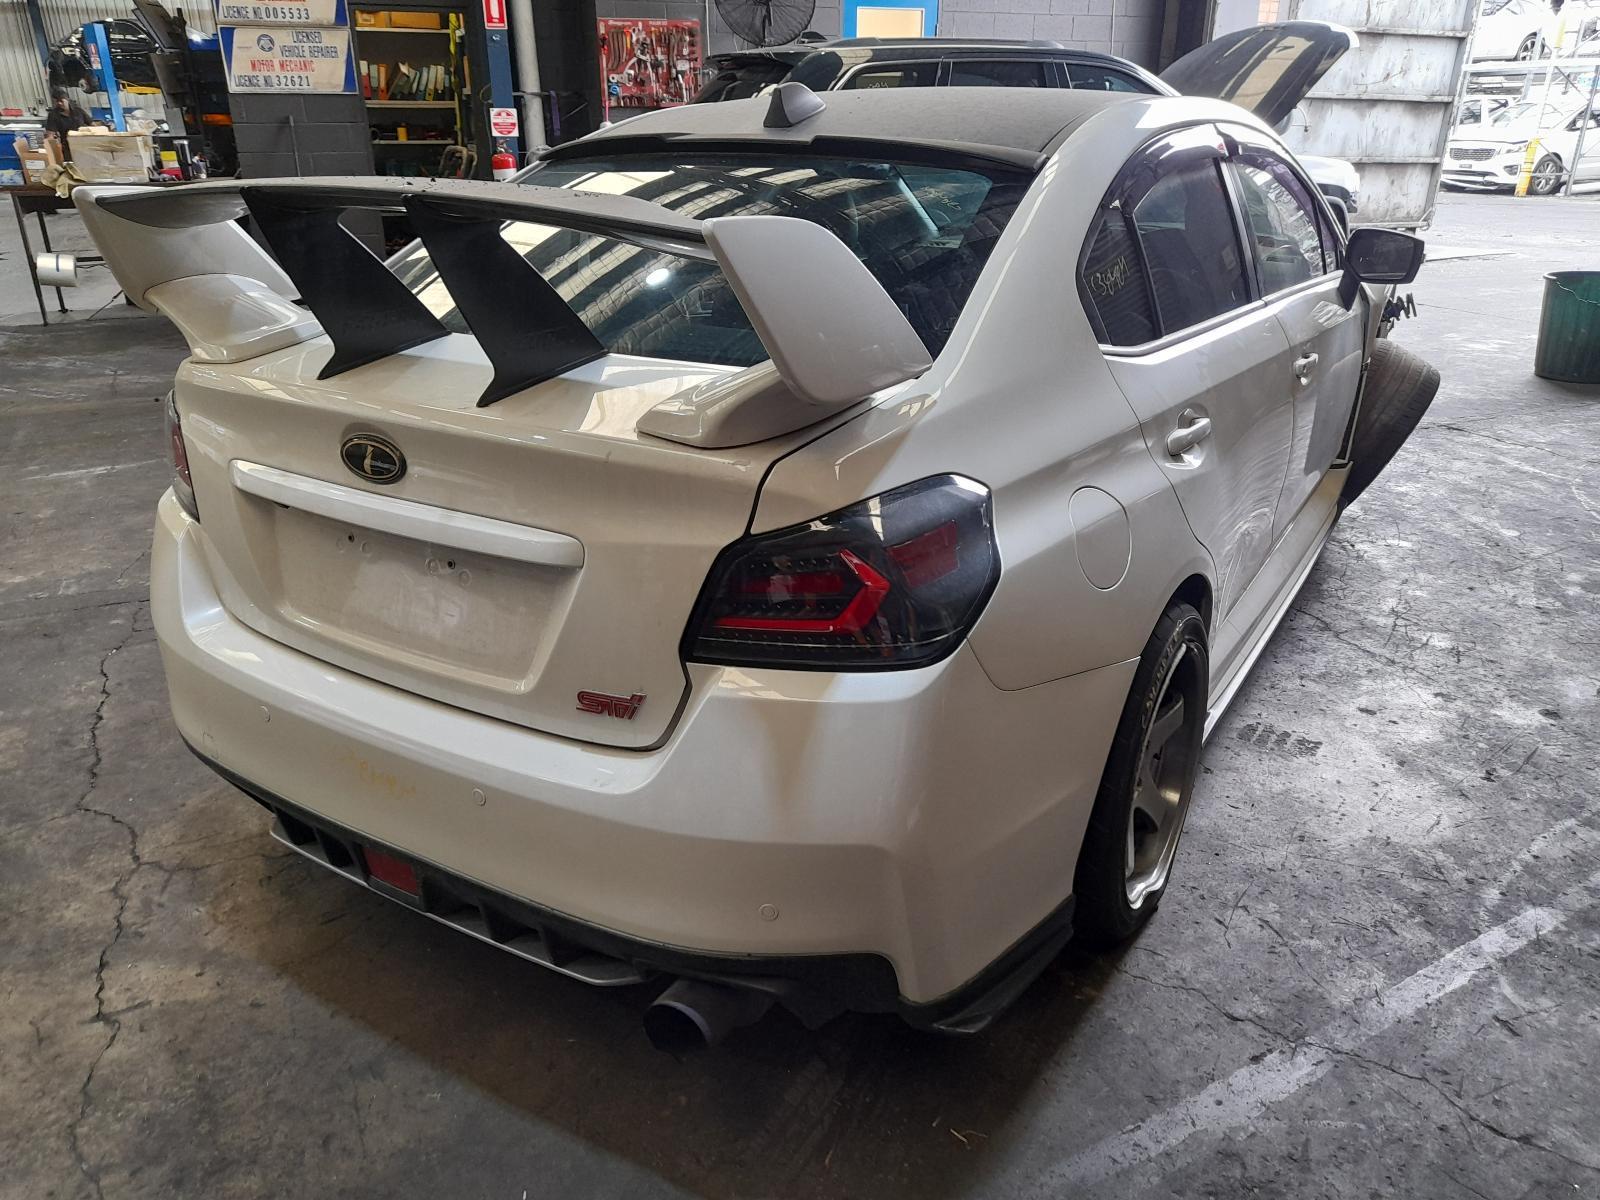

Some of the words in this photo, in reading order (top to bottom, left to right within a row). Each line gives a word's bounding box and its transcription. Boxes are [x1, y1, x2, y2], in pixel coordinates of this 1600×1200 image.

[222, 5, 250, 19] LICENCE
[265, 6, 310, 20] 005533
[292, 31, 322, 43] LICENSED
[280, 45, 306, 58] VEHICLE
[309, 45, 339, 58] REPAIRER
[250, 59, 275, 72] MOTOR
[279, 60, 315, 73] MECHANIC
[234, 74, 261, 88] LICENCE
[275, 75, 311, 87] 32621
